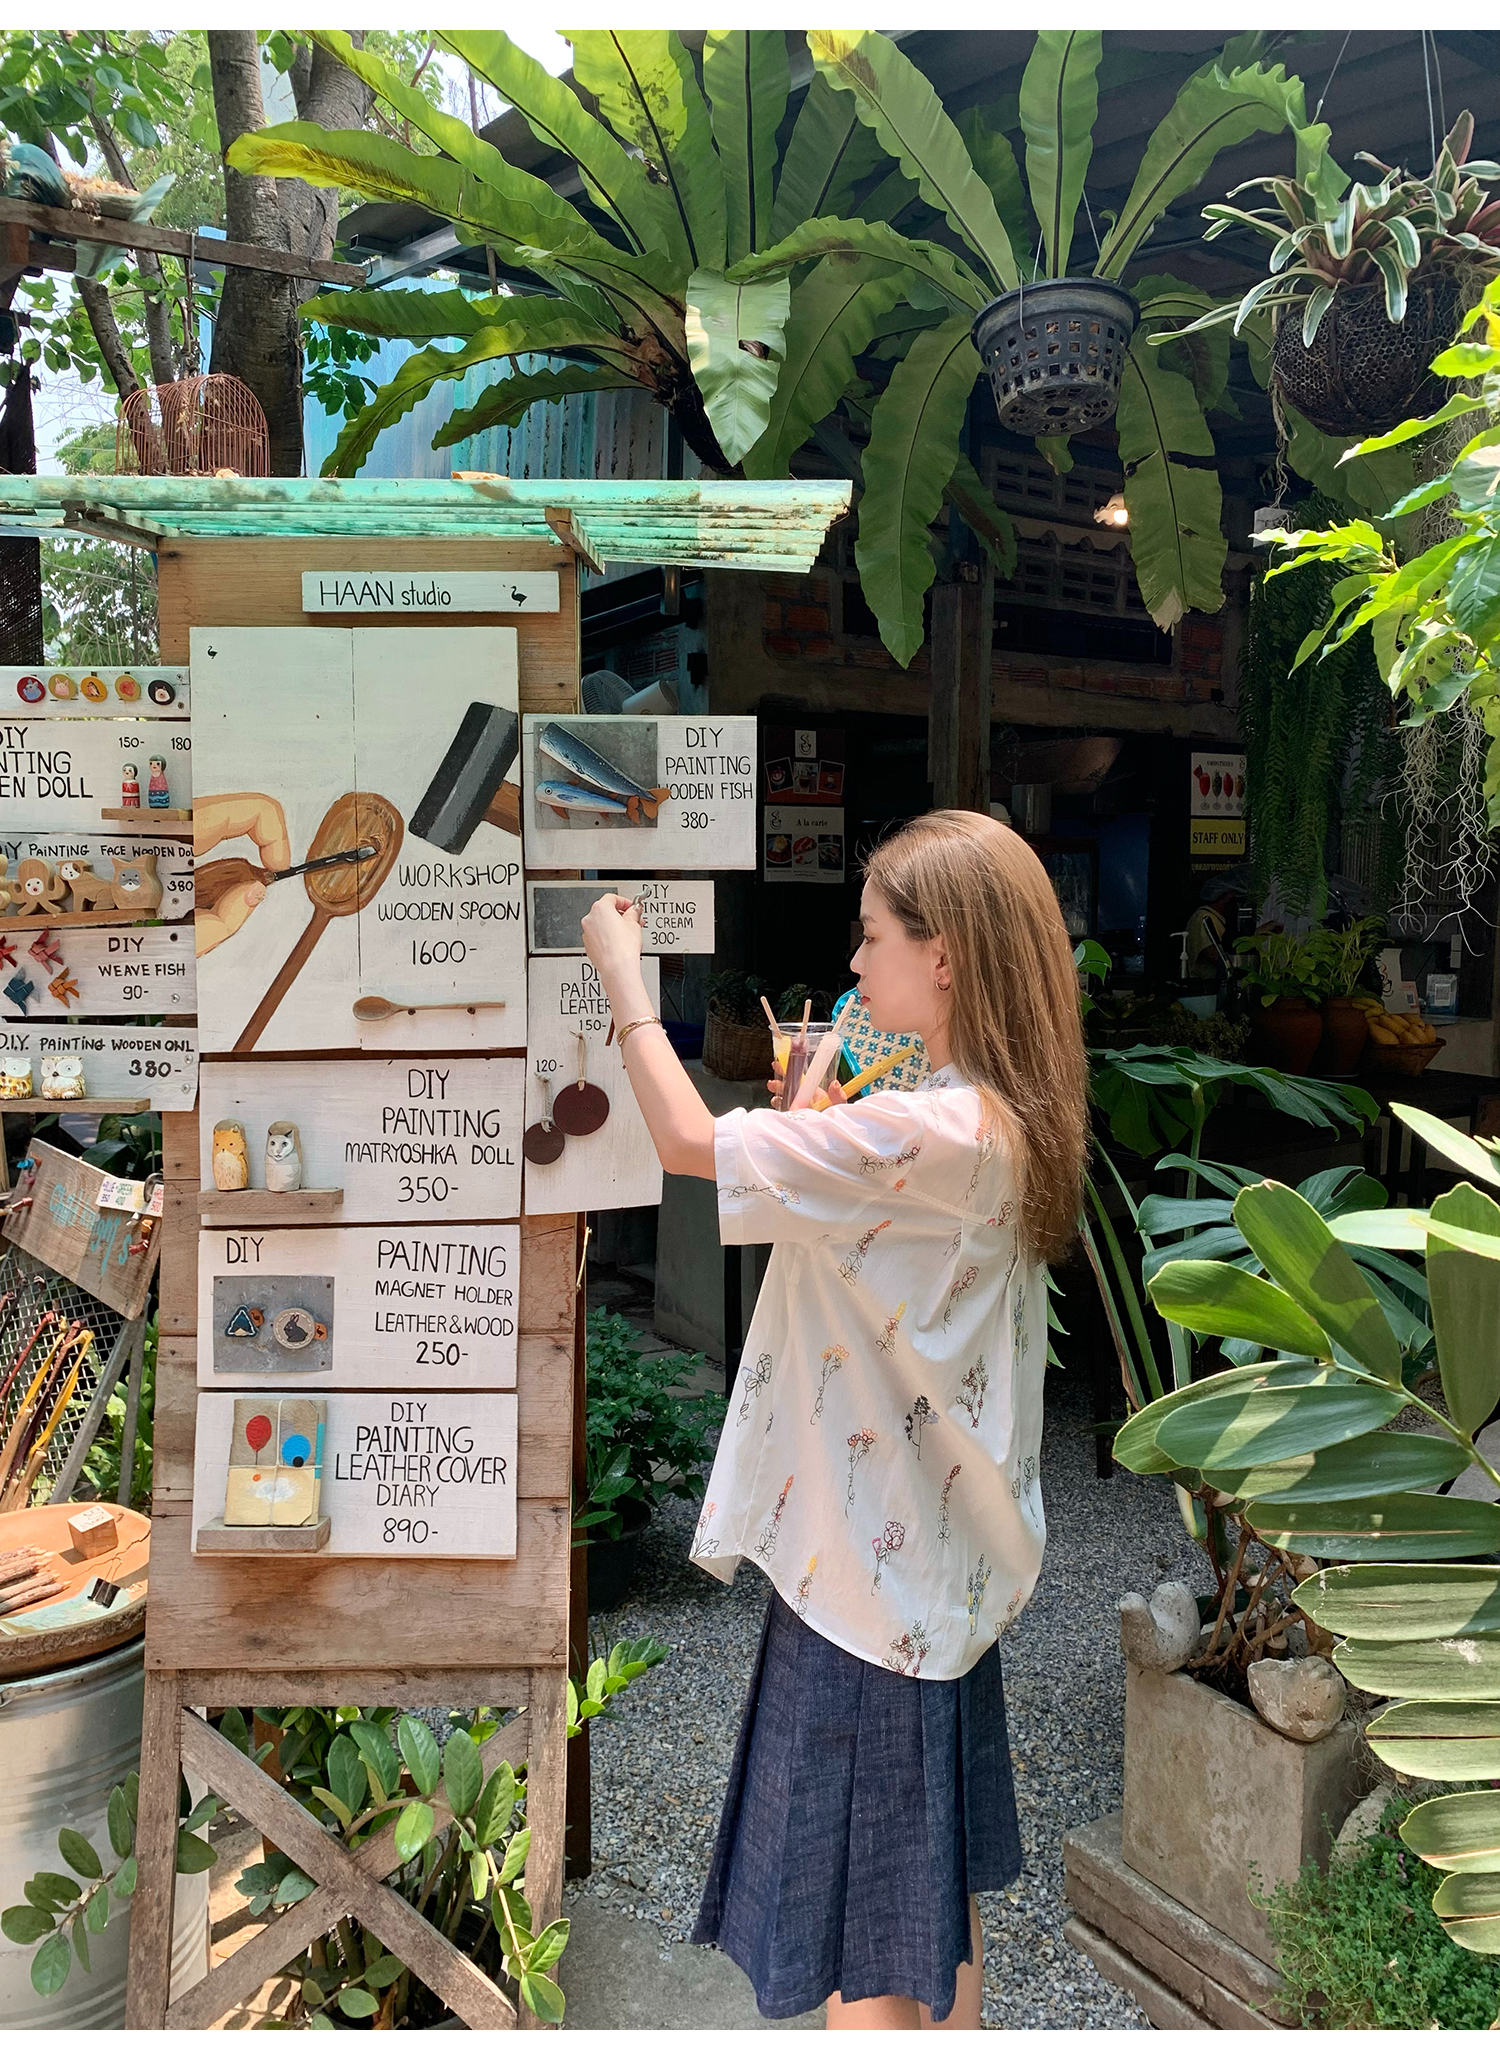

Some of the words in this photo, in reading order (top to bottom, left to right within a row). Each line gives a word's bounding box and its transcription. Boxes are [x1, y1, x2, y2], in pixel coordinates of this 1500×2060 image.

[319, 580, 394, 606] HAAN
[401, 580, 451, 606] studio
[119, 736, 145, 748] 150-
[686, 727, 724, 748] DIY
[665, 756, 751, 775] PAINTING
[38, 776, 93, 798] DOLL
[658, 783, 714, 800] OODEN
[721, 782, 753, 800] FISH
[680, 811, 716, 829] 380-
[1192, 831, 1219, 844] STAFF
[1221, 832, 1244, 844] ONLY
[100, 844, 126, 856] FACE
[399, 863, 520, 888] WORKSHOP
[378, 901, 454, 921] WOODEN
[459, 900, 520, 921] SPOON
[643, 901, 697, 914] INTING
[655, 917, 693, 928] CREAM
[108, 937, 145, 952] DIY
[650, 931, 680, 945] 300-
[412, 940, 477, 965] 1600-
[98, 964, 150, 977] WEAVE
[155, 963, 186, 976] FISH
[581, 963, 600, 981] DI
[561, 982, 601, 999] PAIN
[579, 1019, 607, 1031] 150-
[111, 1039, 161, 1051] WOODEN
[129, 1059, 182, 1078] 380-
[536, 1059, 564, 1072] 120-
[408, 1069, 450, 1100] DIY
[382, 1106, 501, 1138] PAINTING
[345, 1142, 457, 1165] MATRYOSHKA
[471, 1144, 515, 1165] DOLL
[398, 1176, 459, 1203] 350-
[226, 1236, 264, 1264] DIY
[377, 1239, 507, 1277] PAINTING
[375, 1280, 446, 1299] MAGNET
[454, 1285, 513, 1306] HOLDER
[416, 1340, 469, 1366] 250-
[391, 1402, 427, 1422] DIY
[356, 1426, 474, 1454] PAINTING
[335, 1453, 431, 1482] LEATHER
[436, 1456, 507, 1485] COVER
[376, 1484, 440, 1507] DIARY
[383, 1517, 438, 1543] 890-
